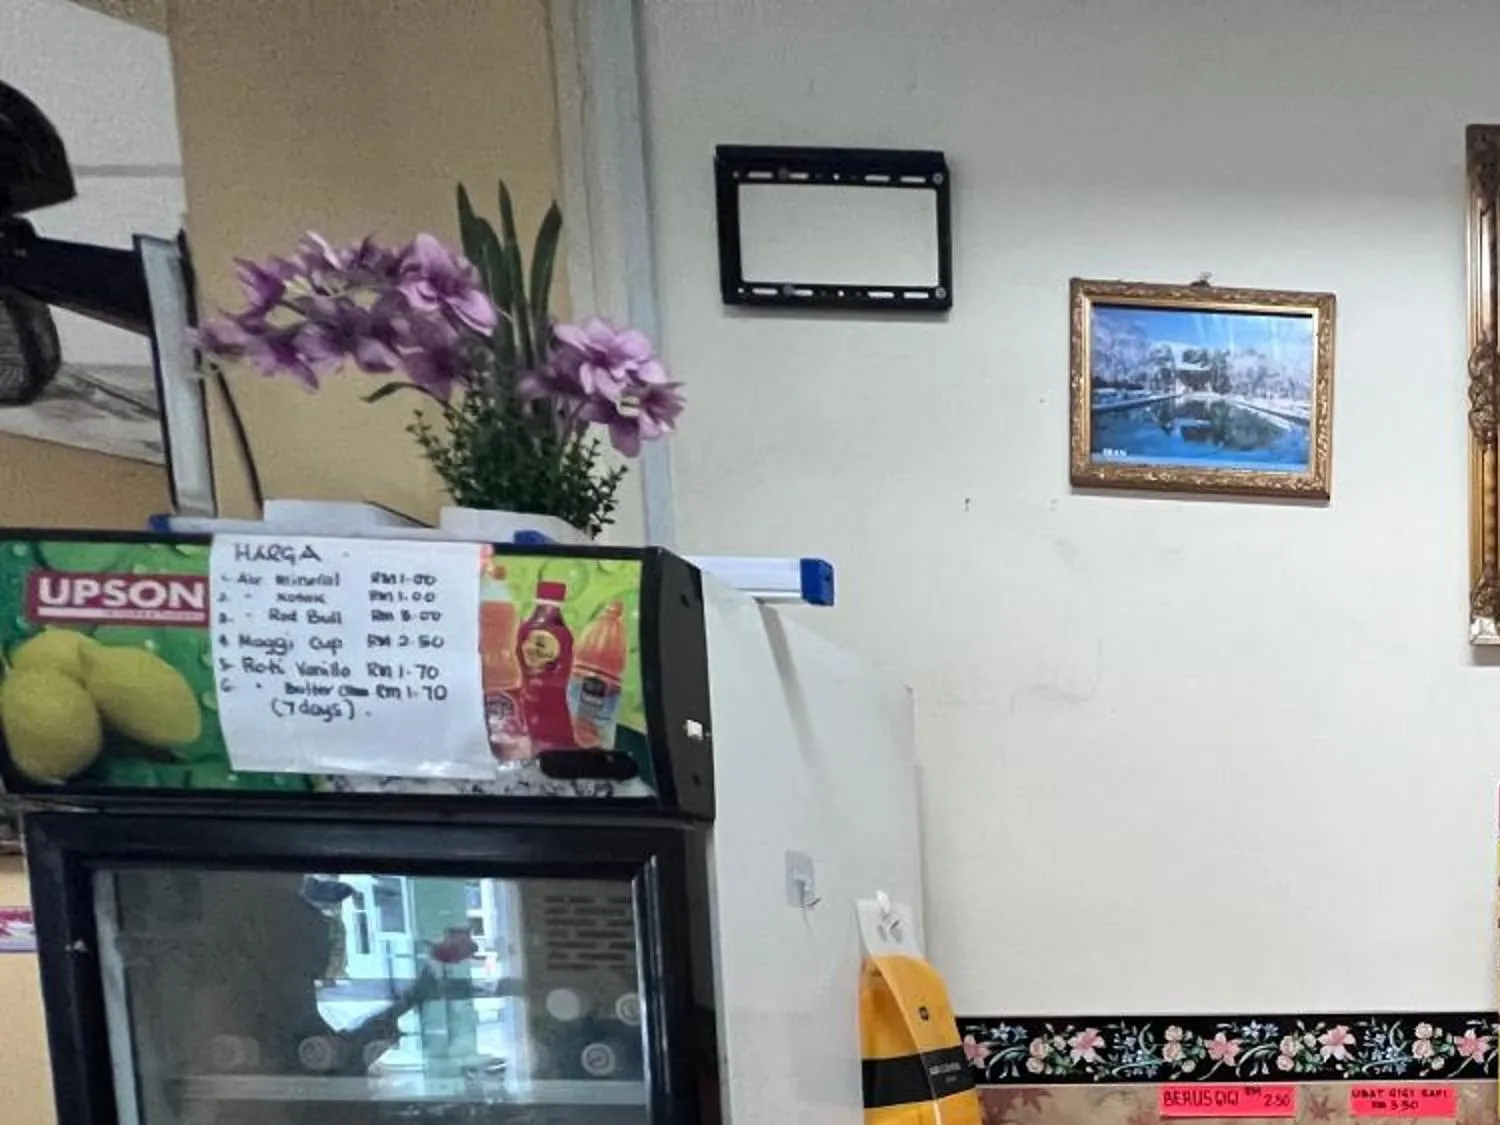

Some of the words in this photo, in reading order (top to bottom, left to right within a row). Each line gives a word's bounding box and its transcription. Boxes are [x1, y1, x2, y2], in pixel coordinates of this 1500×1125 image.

[235, 544, 321, 566] HARGA
[38, 577, 205, 609] UPSON
[306, 609, 342, 624] Bull
[241, 656, 285, 675] Roti
[1163, 1089, 1212, 1106] BERUS
